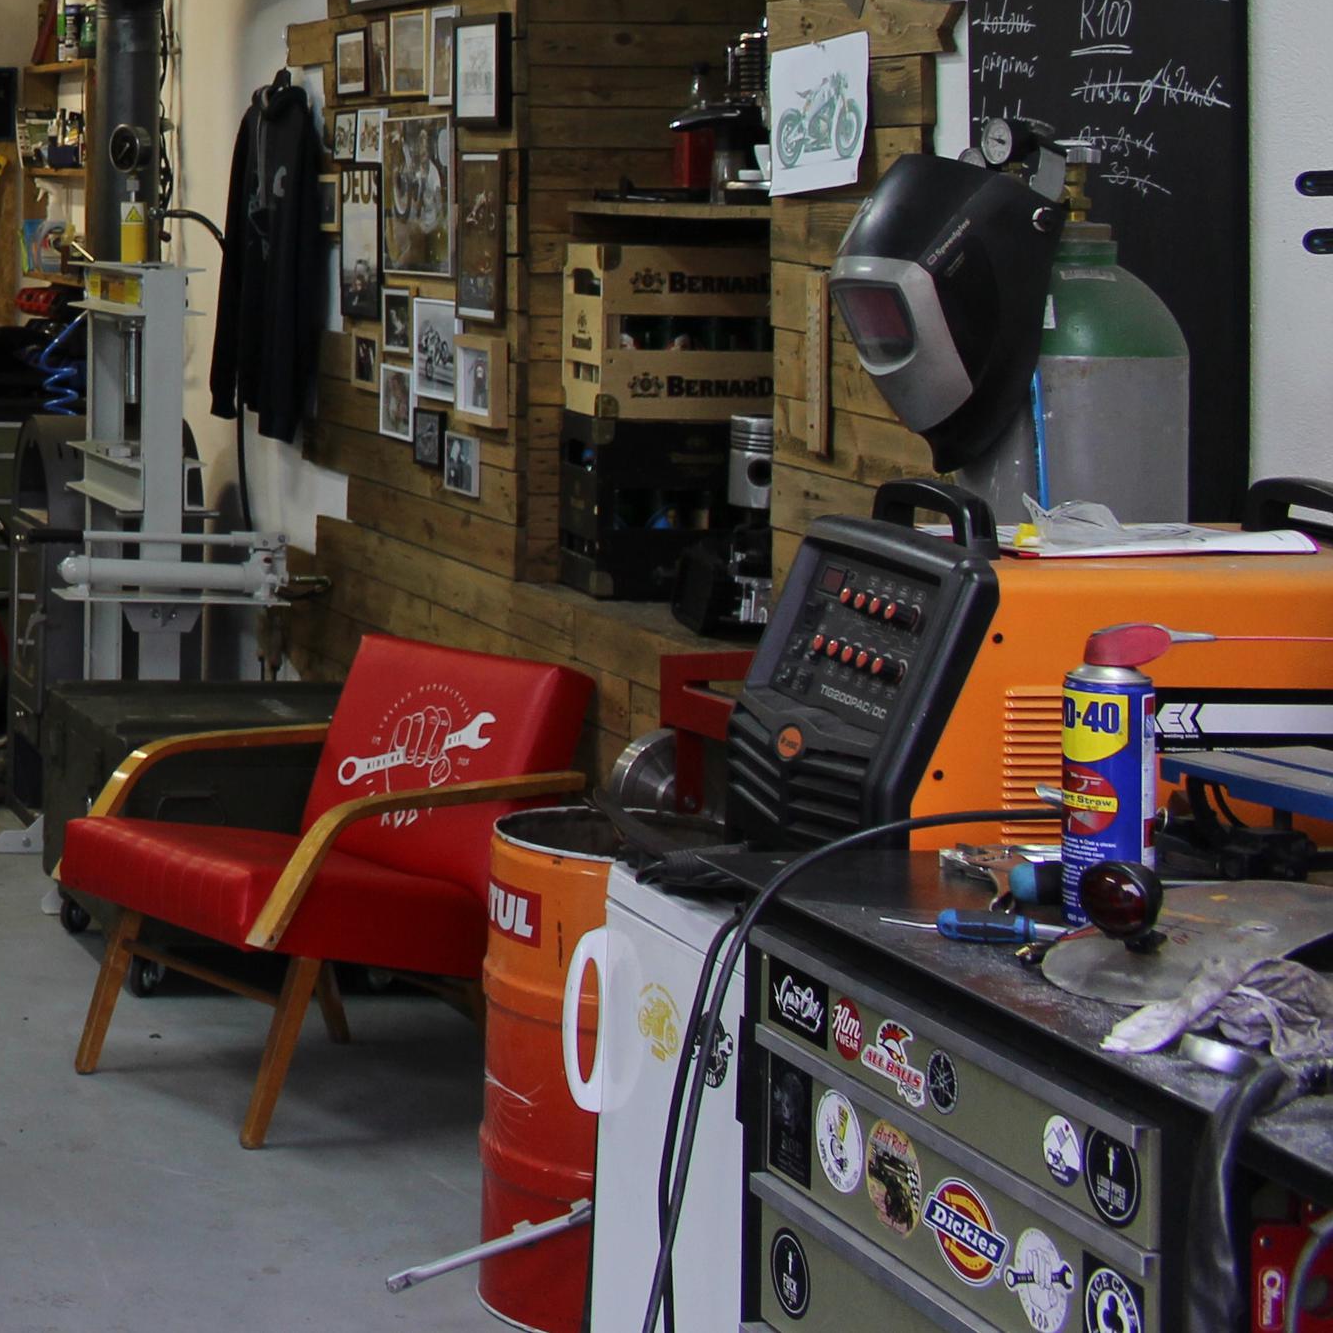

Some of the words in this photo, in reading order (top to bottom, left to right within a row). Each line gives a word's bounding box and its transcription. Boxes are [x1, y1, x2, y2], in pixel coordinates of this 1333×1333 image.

[341, 170, 379, 205] DEUS
[933, 216, 973, 257] Speedglas
[666, 375, 774, 398] BERNARD
[1064, 696, 1120, 735] D-40
[1163, 733, 1185, 741] welding
[1076, 795, 1112, 807] Straw
[488, 880, 534, 939] TUL
[838, 1033, 859, 1053] WEAR
[864, 1049, 882, 1069] ALL
[885, 1061, 923, 1088] BALLS
[891, 1135, 910, 1155] Rod
[931, 1204, 999, 1258] Dickies
[1090, 1272, 1110, 1304] ACE
[1031, 1307, 1049, 1330] ROD
